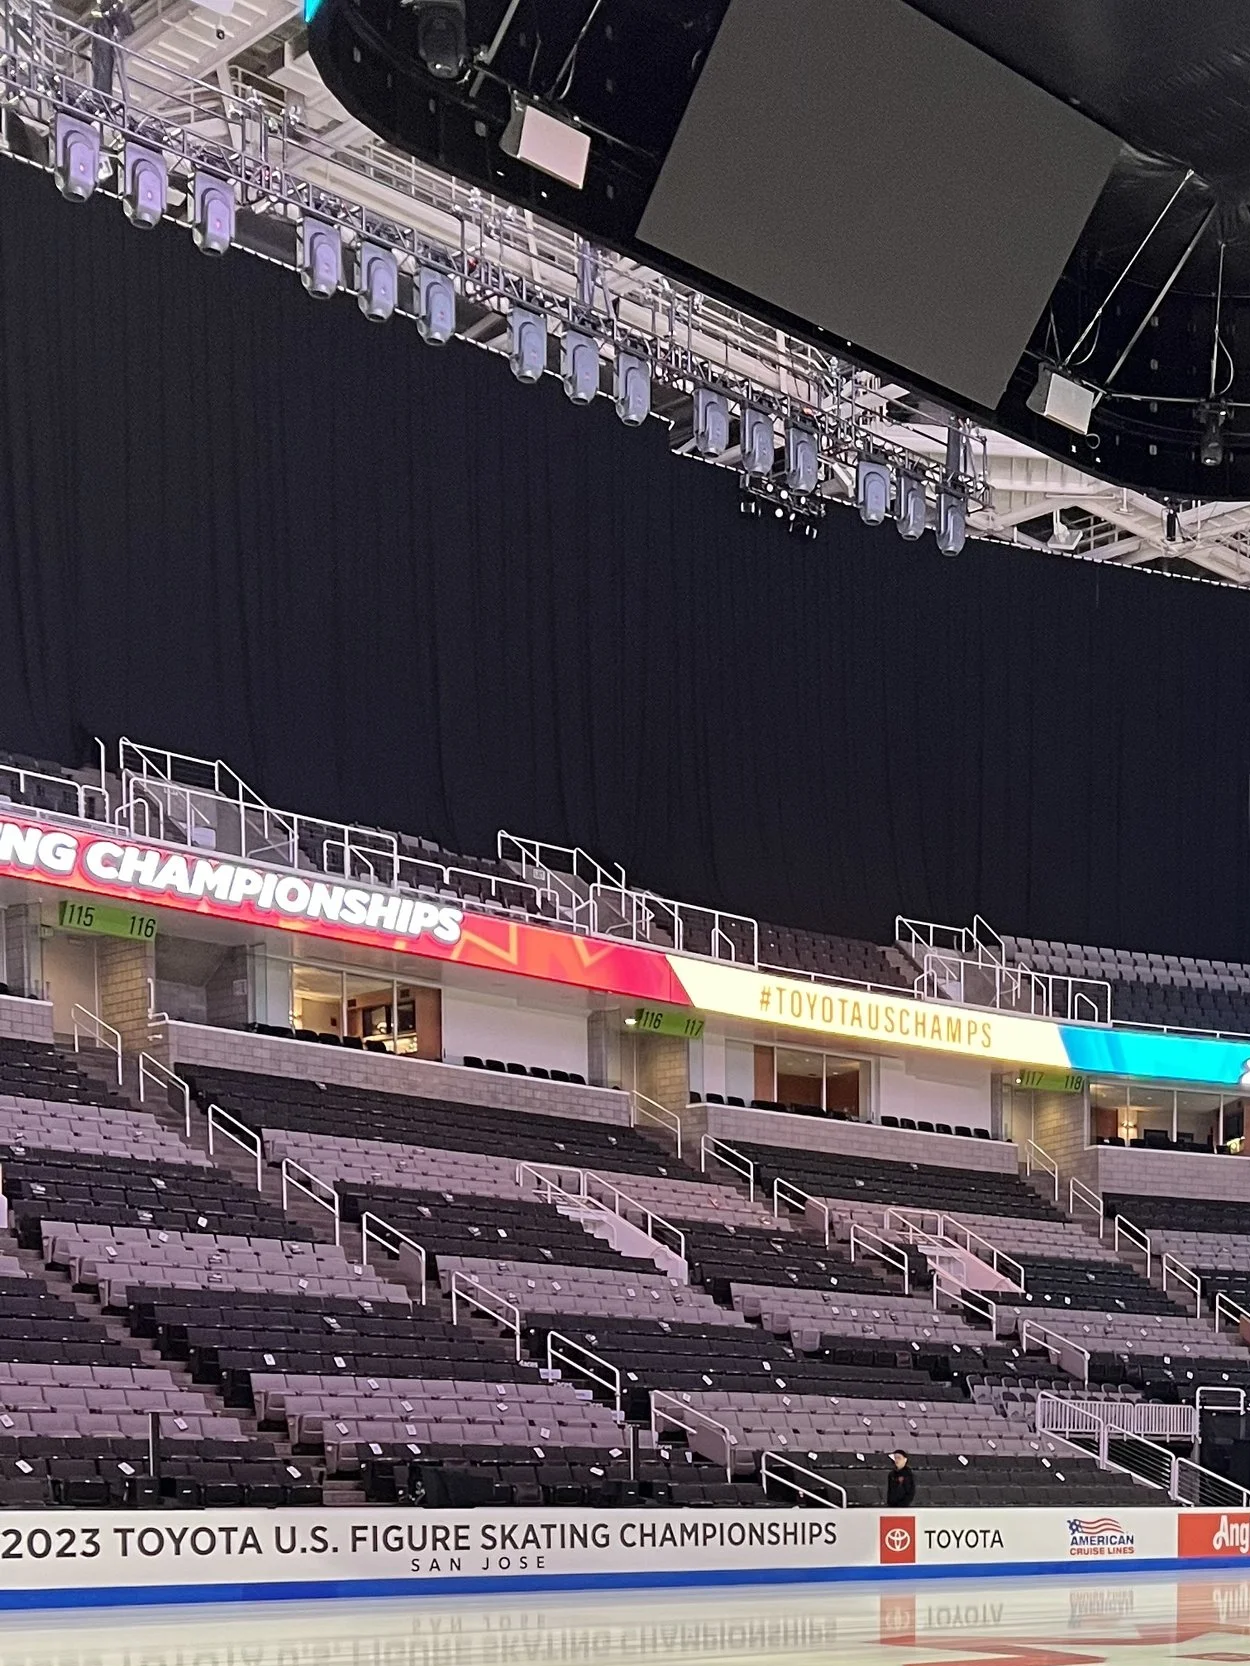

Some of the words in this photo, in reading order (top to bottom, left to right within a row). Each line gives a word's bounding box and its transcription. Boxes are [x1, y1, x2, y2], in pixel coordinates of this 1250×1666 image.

[0, 822, 78, 871] NG
[86, 841, 464, 942] CHAMPIONSHIPS
[68, 903, 95, 927] 115
[129, 916, 156, 938] 116
[642, 1012, 663, 1029] 116
[759, 985, 993, 1048] #TOYOTAUSCHAMPS
[684, 1018, 705, 1037] 117
[1025, 1070, 1045, 1086] 117
[1064, 1075, 1083, 1090] 118
[1, 1528, 100, 1559] 2023
[113, 1526, 263, 1557] TOYOTA
[274, 1525, 339, 1554] U.S.
[351, 1524, 471, 1554] FIGURE
[480, 1523, 610, 1551] SKATING
[619, 1521, 838, 1548] CHAMPIONSHIPS
[924, 1529, 1004, 1550] TOYOTA
[1070, 1534, 1135, 1547] AMERICAN
[1069, 1545, 1106, 1556] CRUISE
[1107, 1545, 1135, 1555] LINES
[411, 1557, 462, 1573] SAN
[481, 1556, 546, 1571] JOSE
